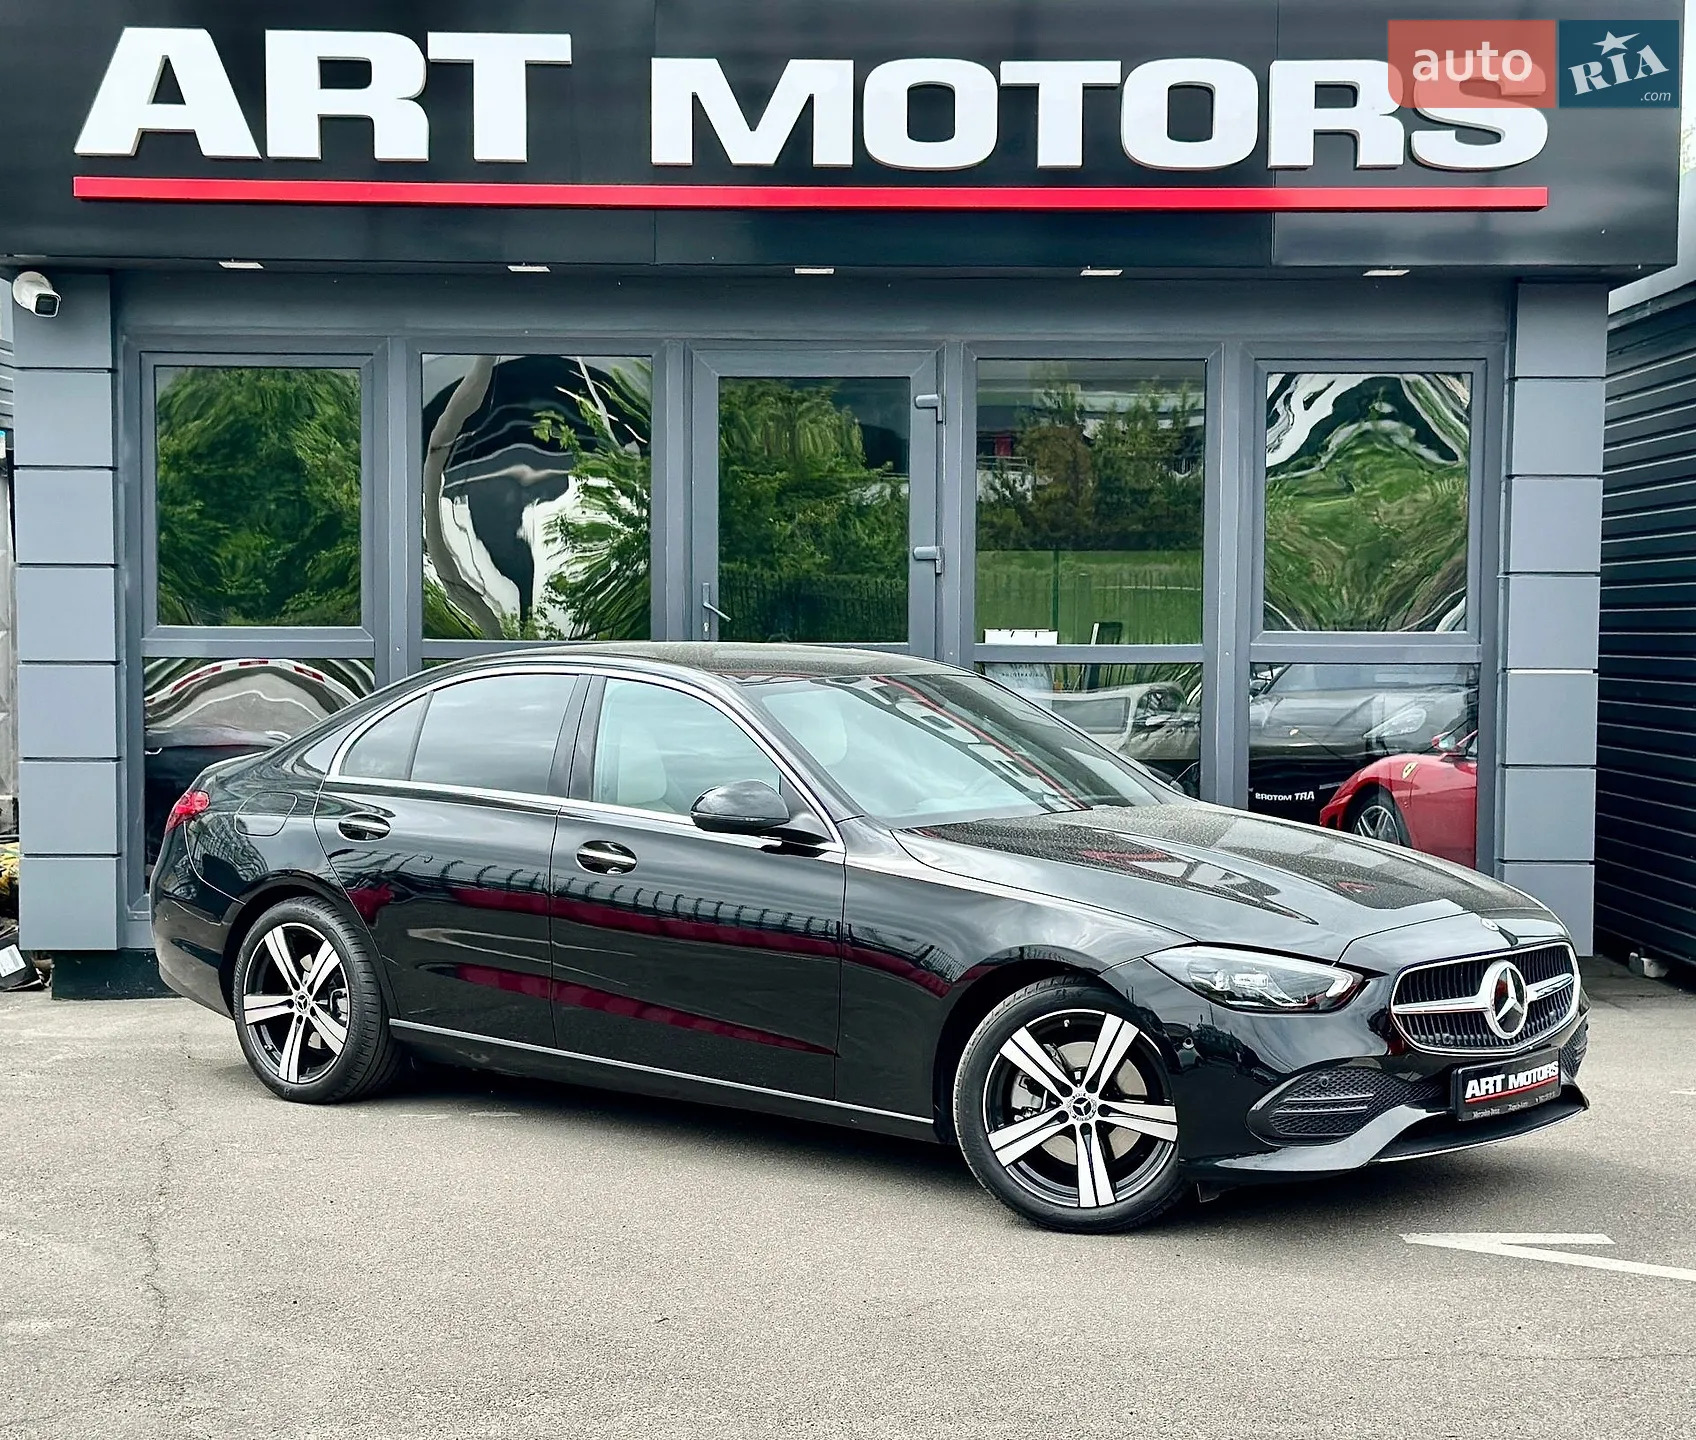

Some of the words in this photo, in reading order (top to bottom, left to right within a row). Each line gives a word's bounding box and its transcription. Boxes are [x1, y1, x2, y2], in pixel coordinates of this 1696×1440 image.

[73, 26, 572, 163] ART
[650, 56, 1549, 172] MOTORS
[1465, 1074, 1505, 1099] ART
[1508, 1060, 1559, 1090] MOTORS
